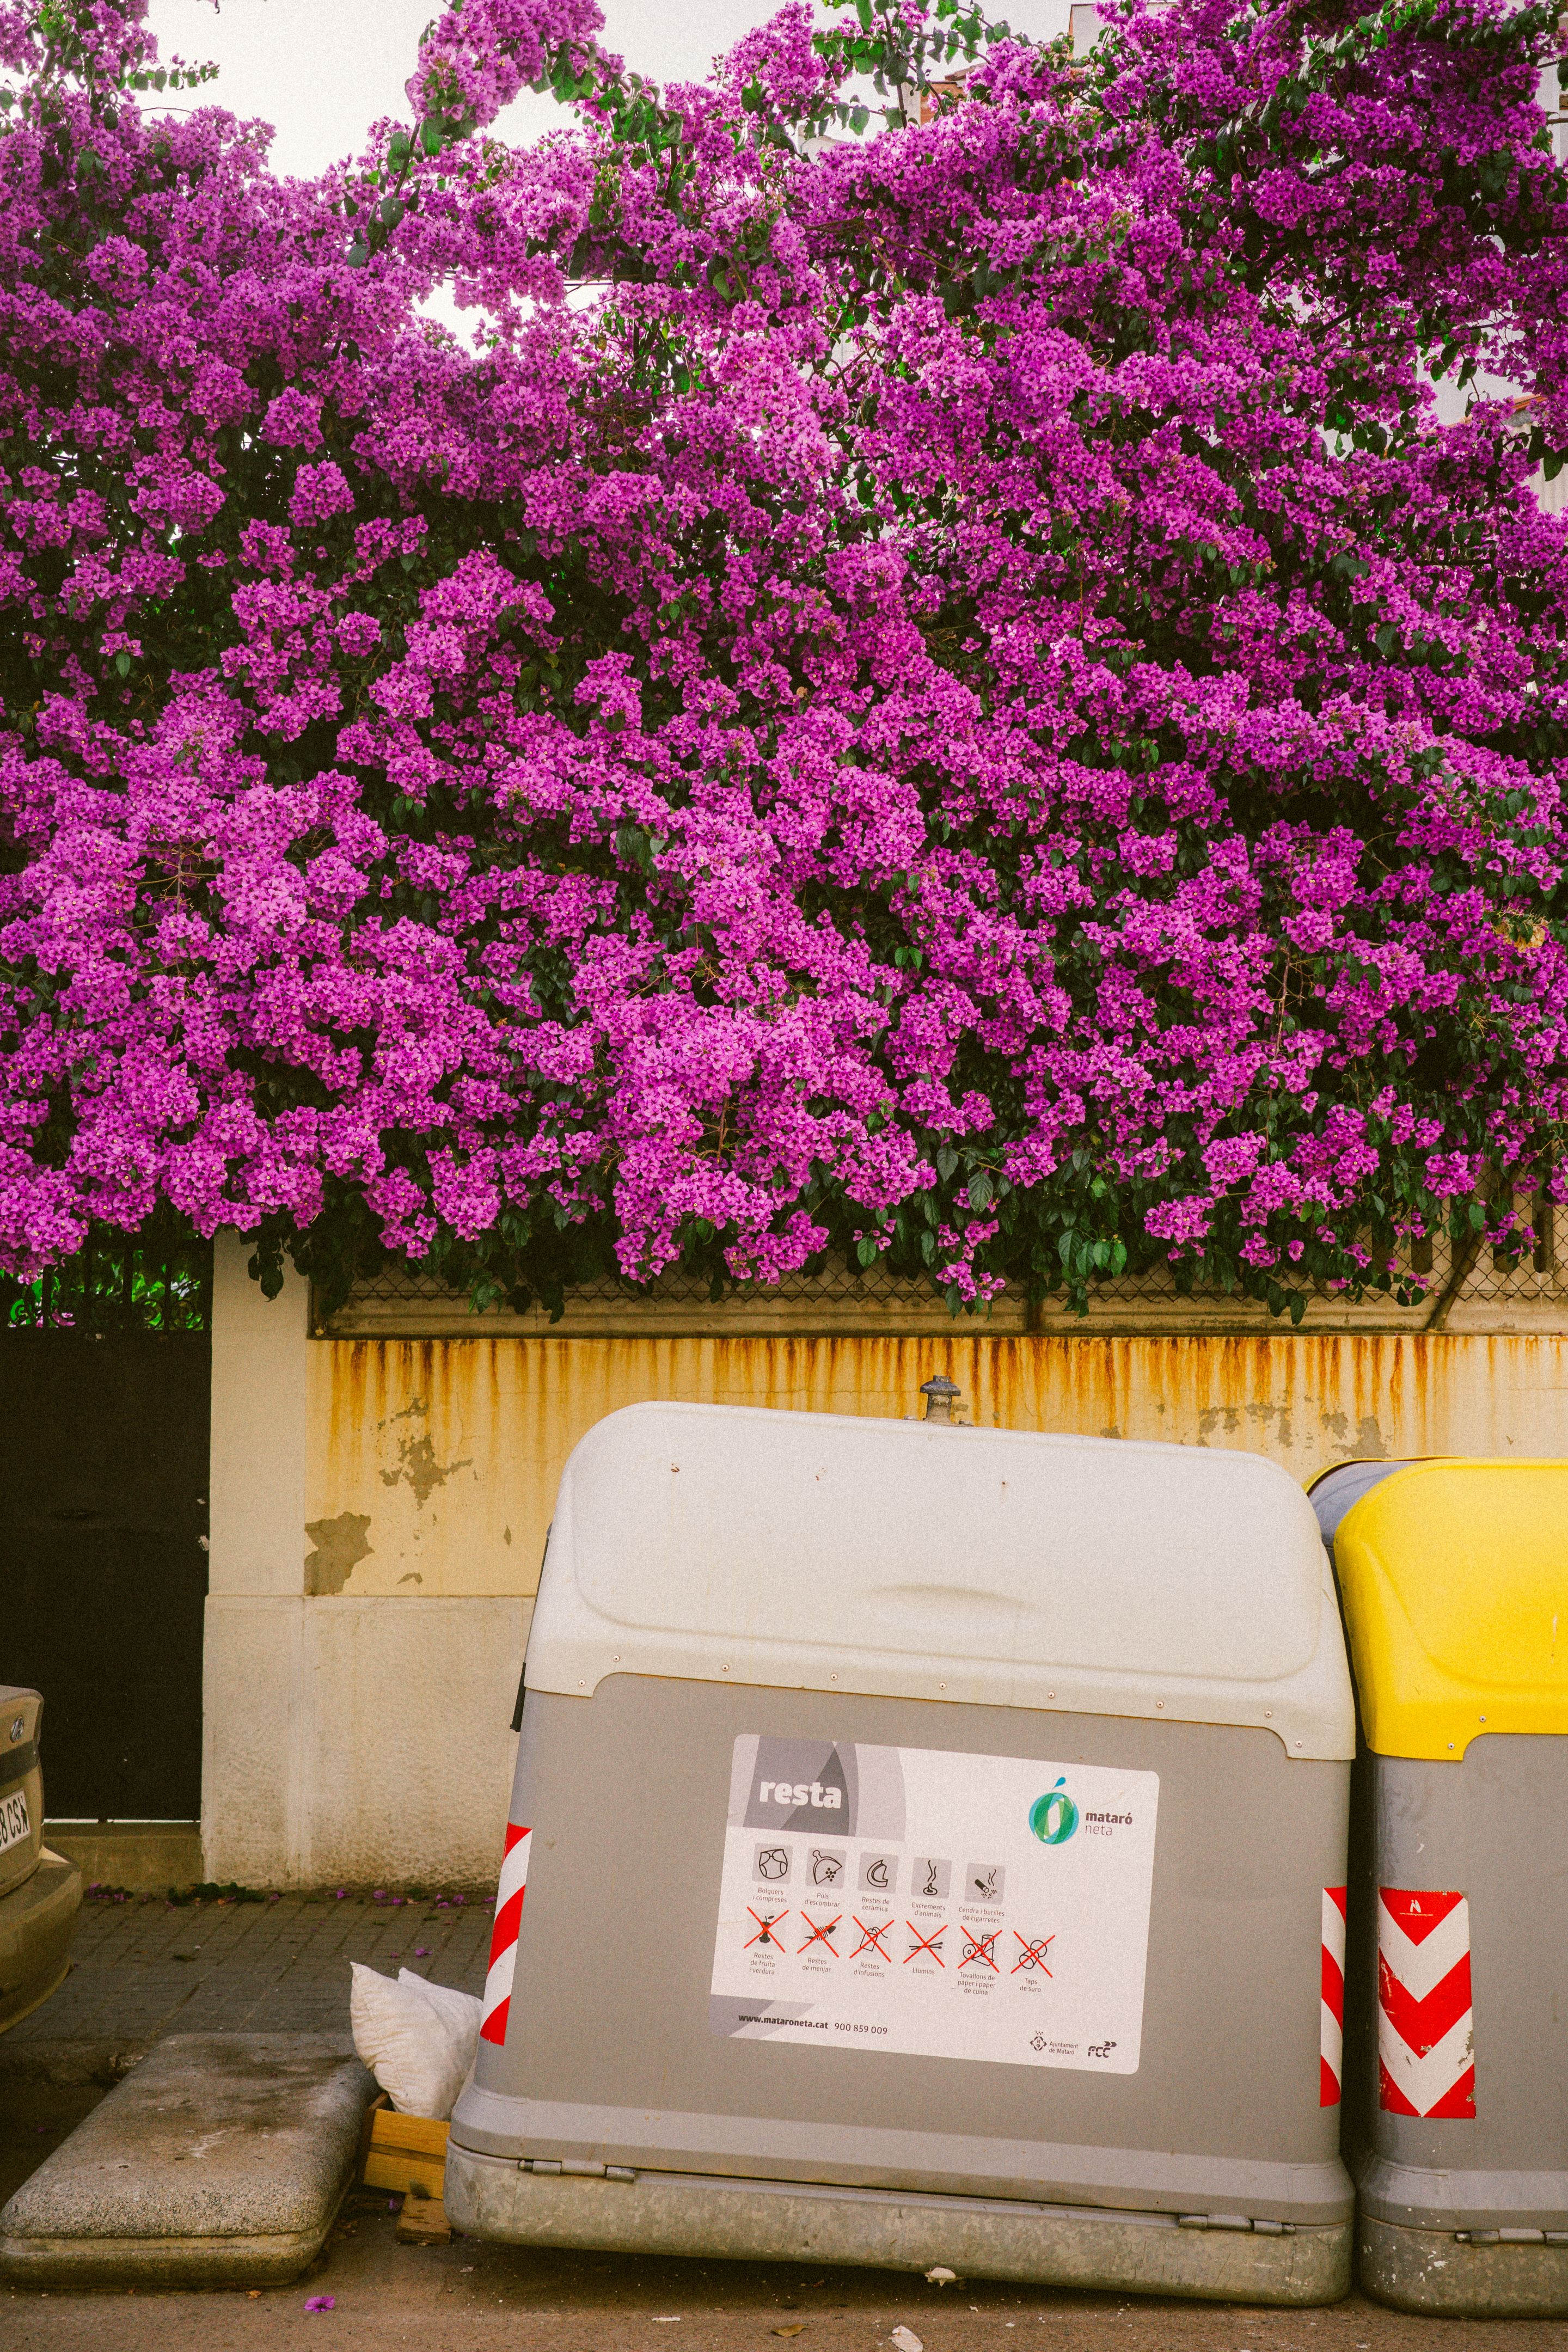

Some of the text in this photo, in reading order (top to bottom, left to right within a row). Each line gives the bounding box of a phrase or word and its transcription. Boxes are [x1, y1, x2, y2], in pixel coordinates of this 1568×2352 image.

[759, 1781, 842, 1809] resta
[1086, 1812, 1132, 1824] mataró
[1085, 1825, 1112, 1836] neta
[912, 1902, 945, 1911] Excrements
[854, 1969, 885, 1977] d'infusions
[960, 1972, 987, 1980] Tovallons
[738, 2014, 887, 2034] www.mataroneta.cat 900 859 009
